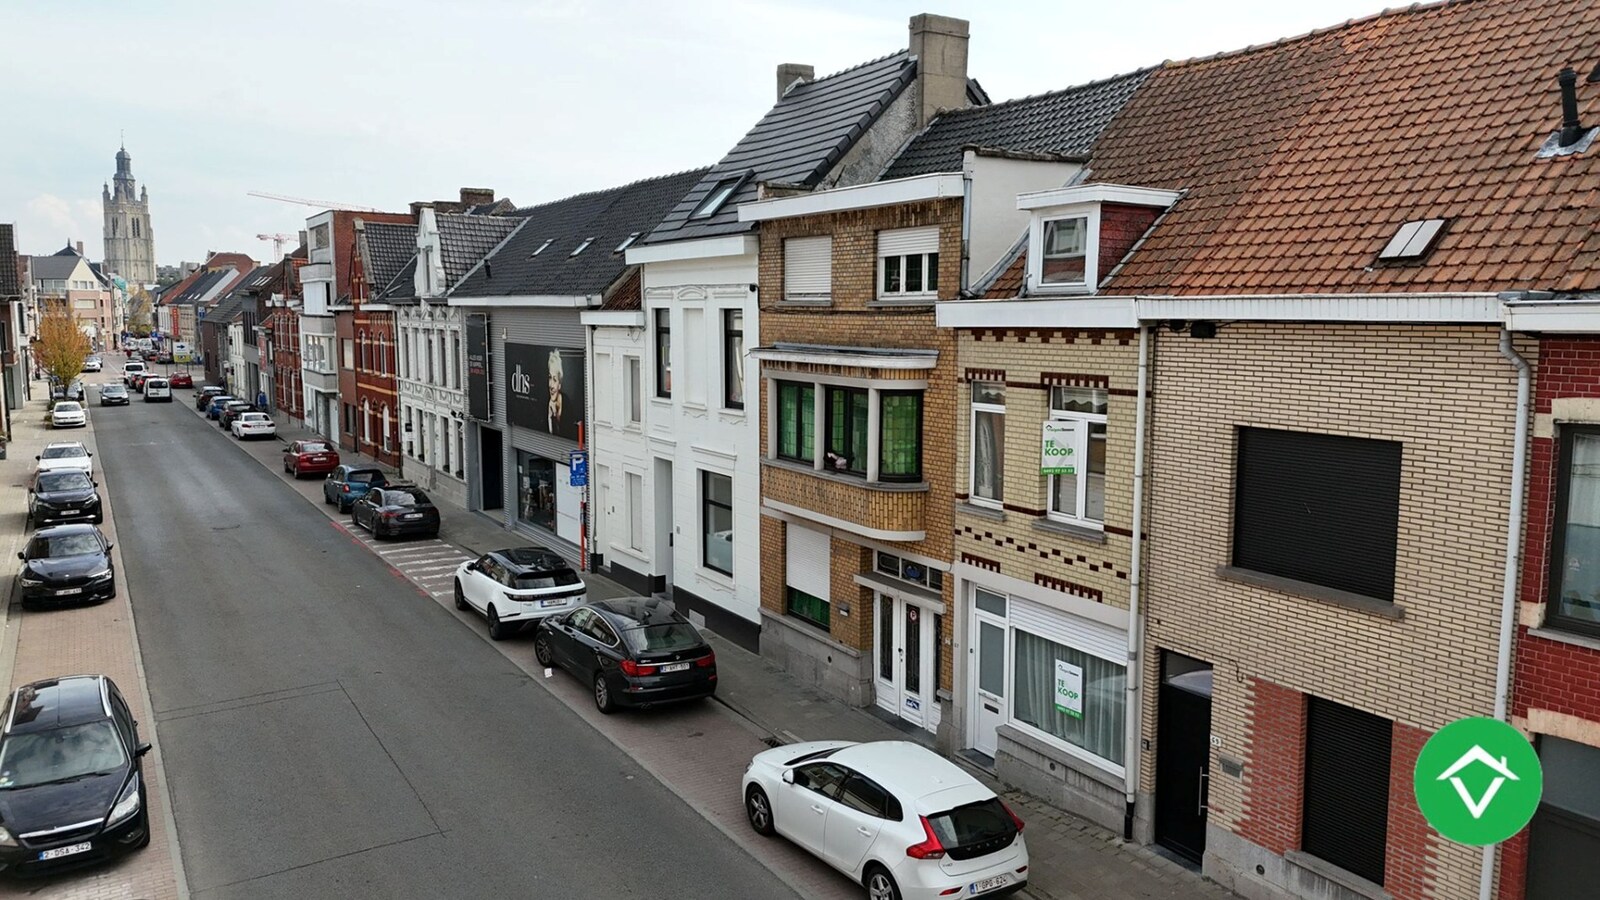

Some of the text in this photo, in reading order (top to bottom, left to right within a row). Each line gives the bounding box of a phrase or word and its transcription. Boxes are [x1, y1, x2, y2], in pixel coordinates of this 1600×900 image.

[511, 364, 530, 394] dhs
[1045, 440, 1055, 448] TE
[1045, 448, 1074, 456] KOOP
[572, 454, 584, 471] P
[1057, 678, 1065, 688] TE
[1057, 686, 1079, 700] KOOP
